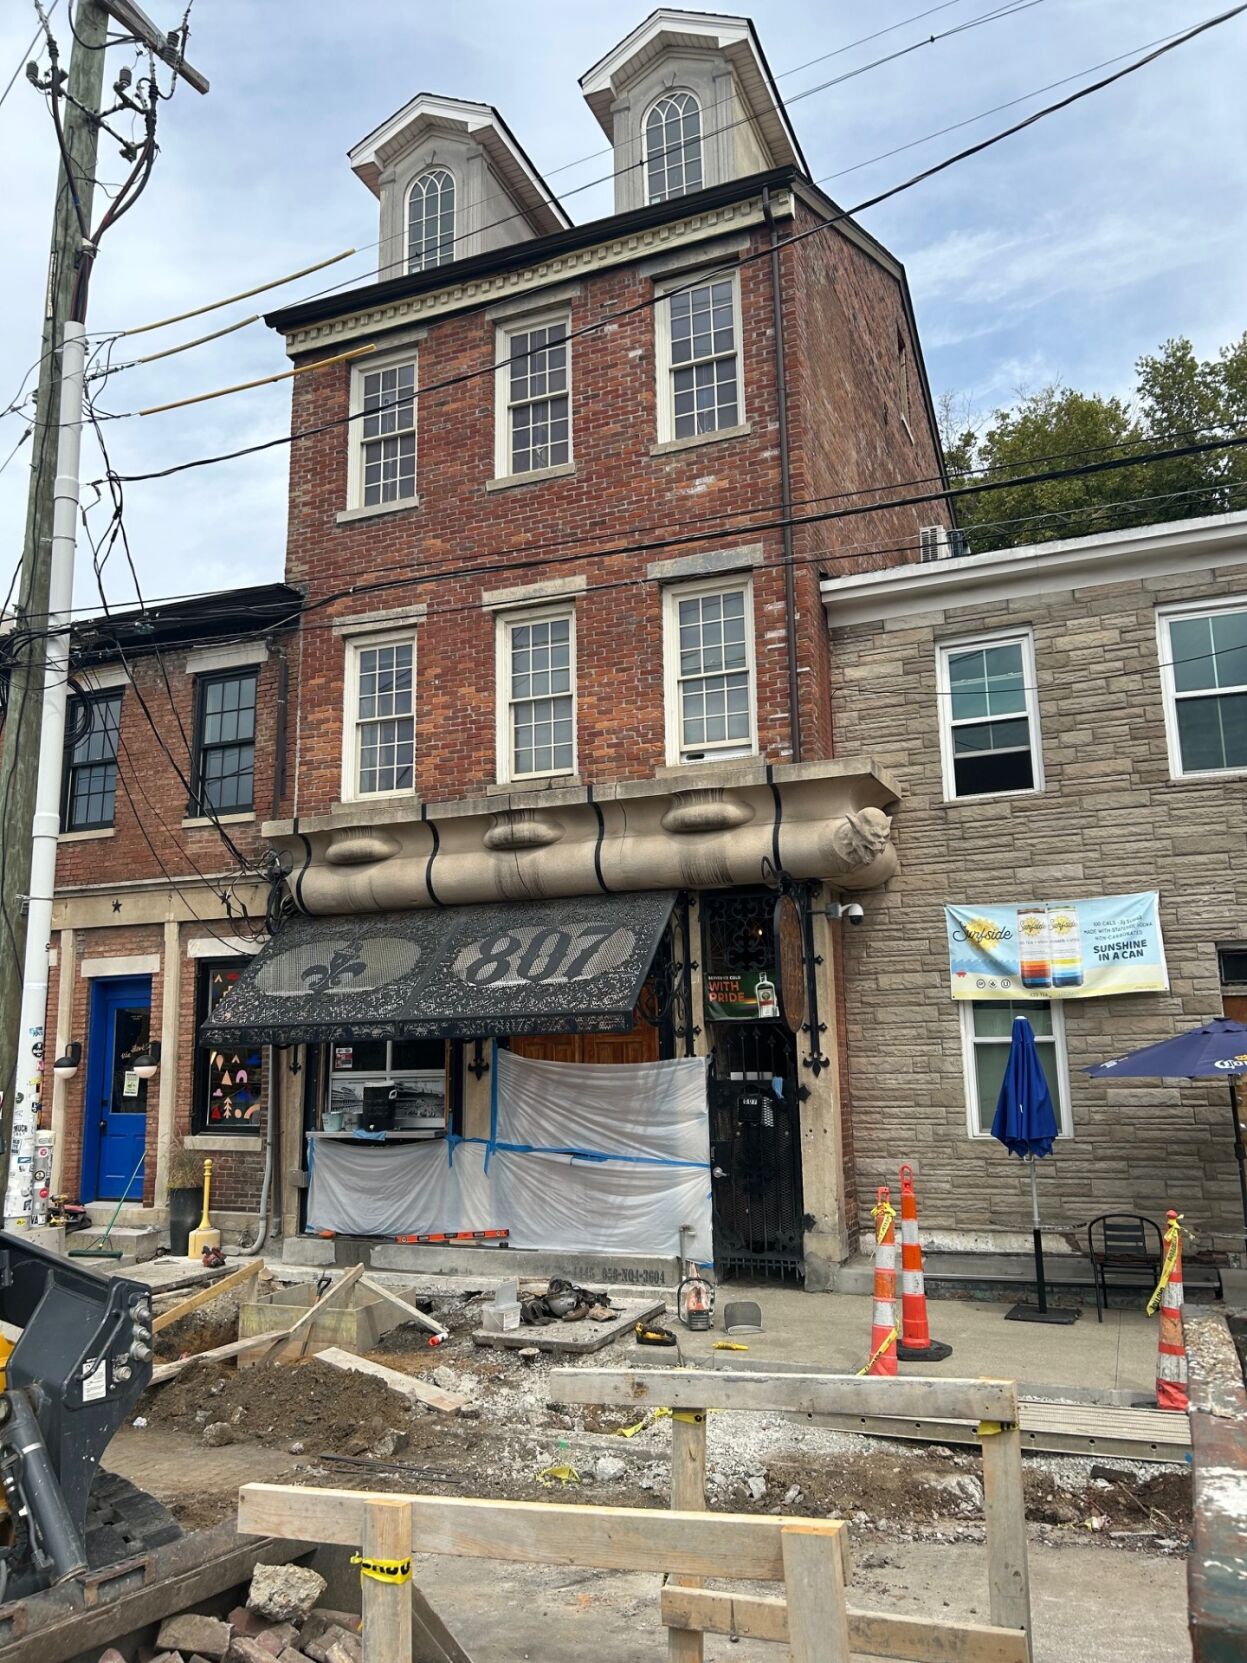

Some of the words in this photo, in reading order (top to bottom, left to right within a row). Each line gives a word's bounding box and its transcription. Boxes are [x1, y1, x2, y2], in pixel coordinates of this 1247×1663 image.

[953, 921, 1013, 942] Surfside
[1093, 939, 1148, 954] SUNSHINE
[466, 922, 626, 987] 807
[1098, 952, 1110, 961] IN
[1112, 951, 1120, 960] A
[1121, 949, 1144, 960] CAN
[709, 981, 740, 992] WITH
[709, 992, 745, 1003] PRIDE
